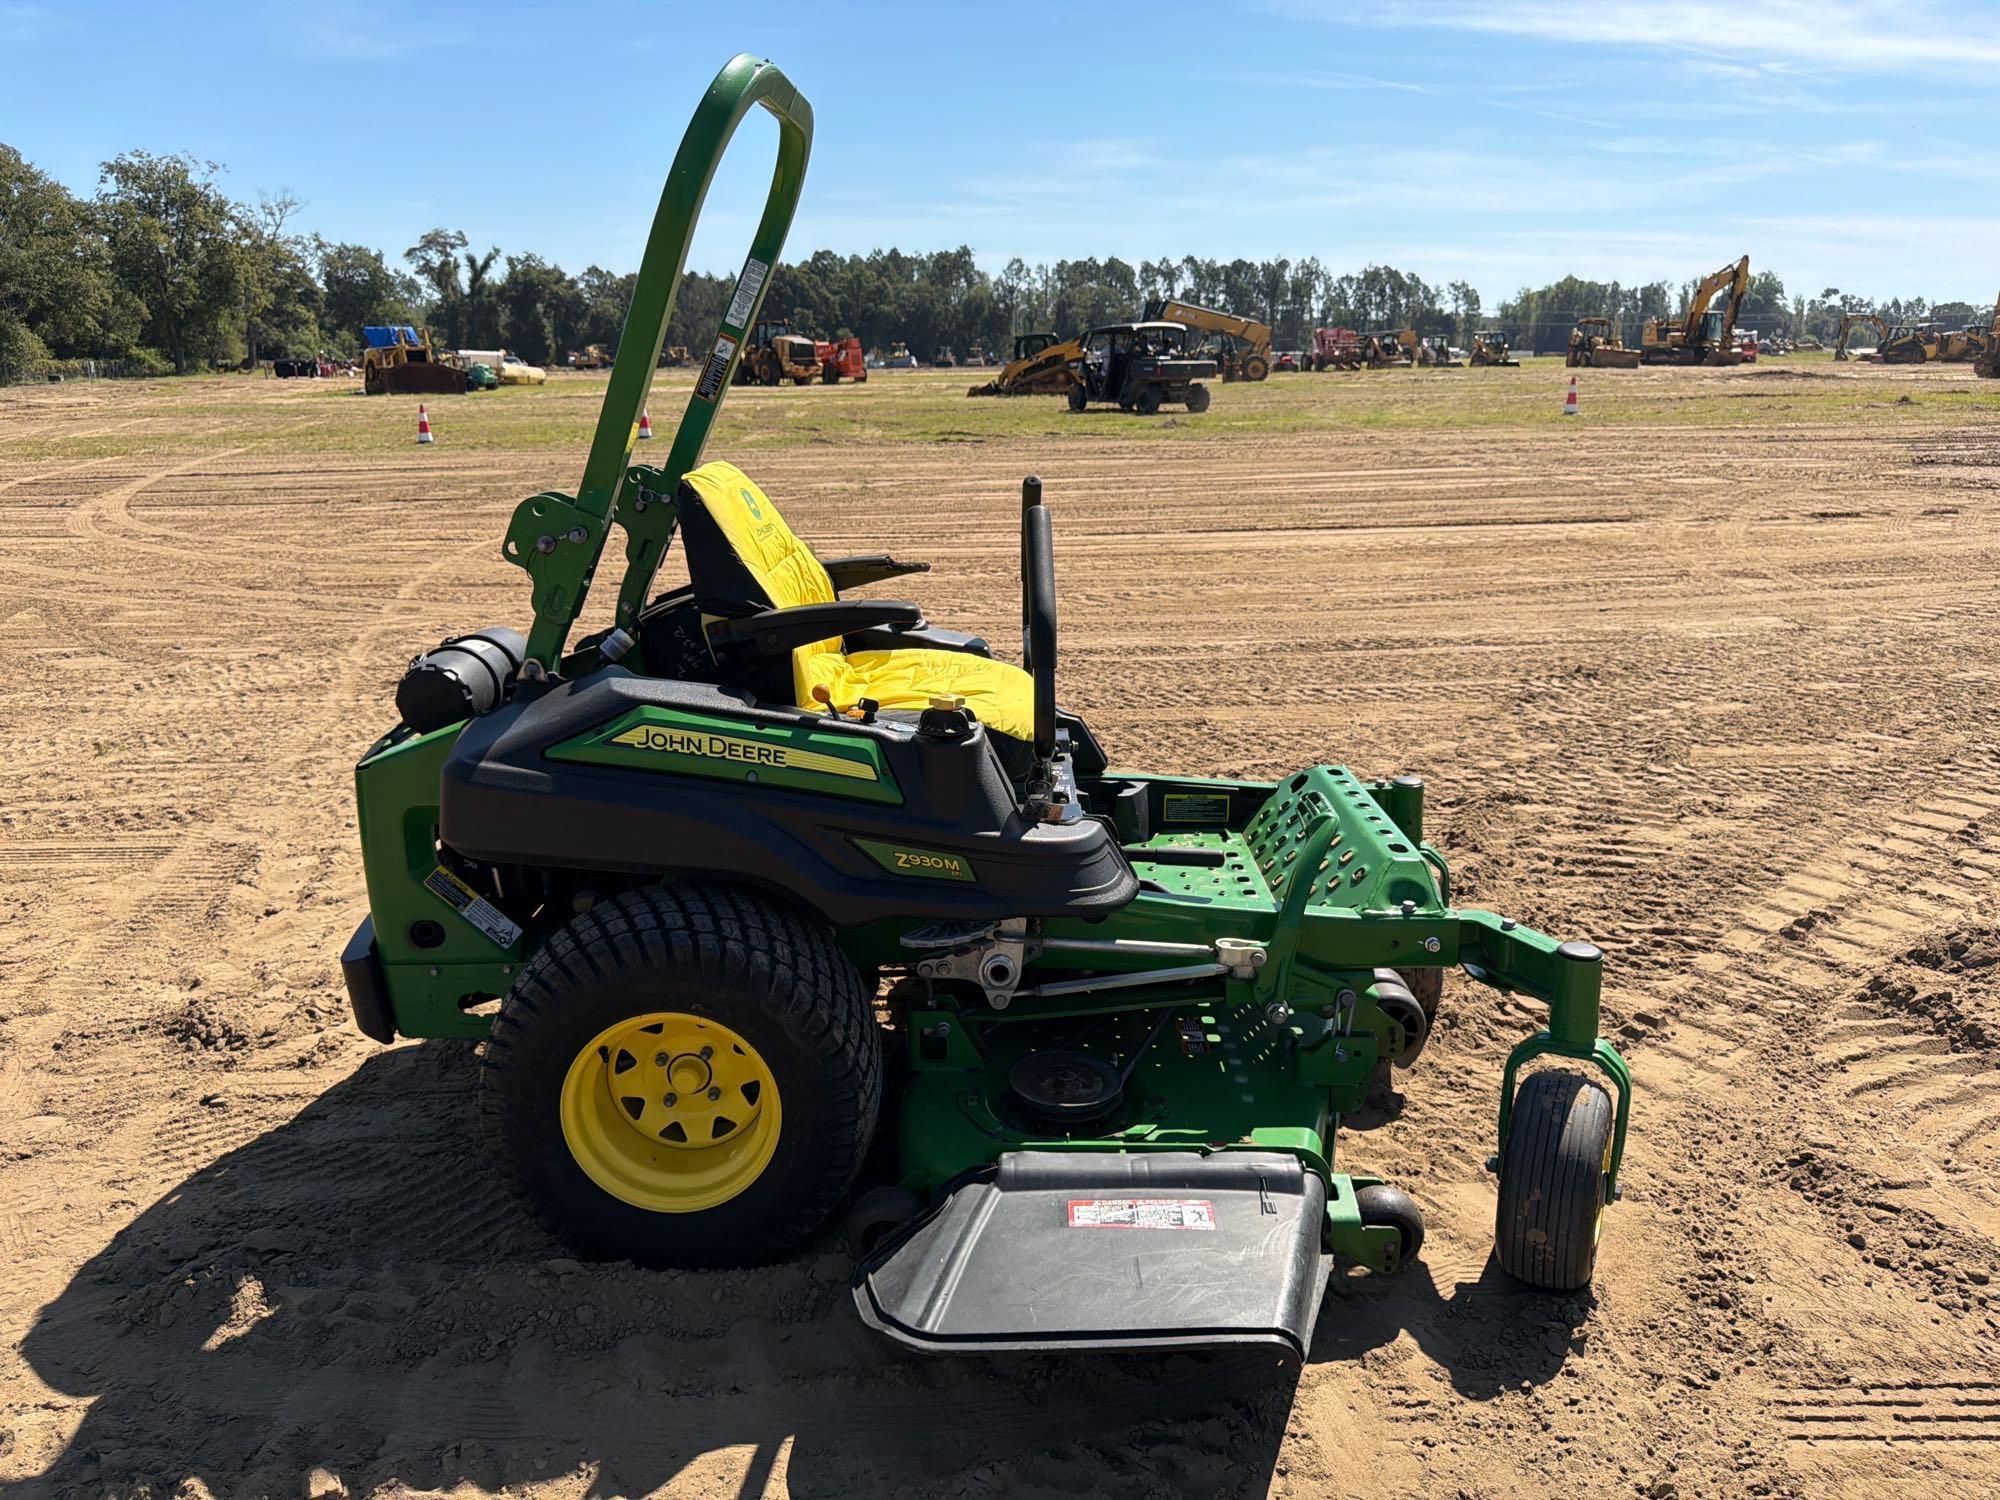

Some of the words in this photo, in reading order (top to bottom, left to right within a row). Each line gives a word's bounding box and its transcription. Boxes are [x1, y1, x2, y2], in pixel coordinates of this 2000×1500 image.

[637, 729, 702, 752] JOHN
[709, 737, 787, 765] DEERE
[894, 852, 960, 870] Z930M
